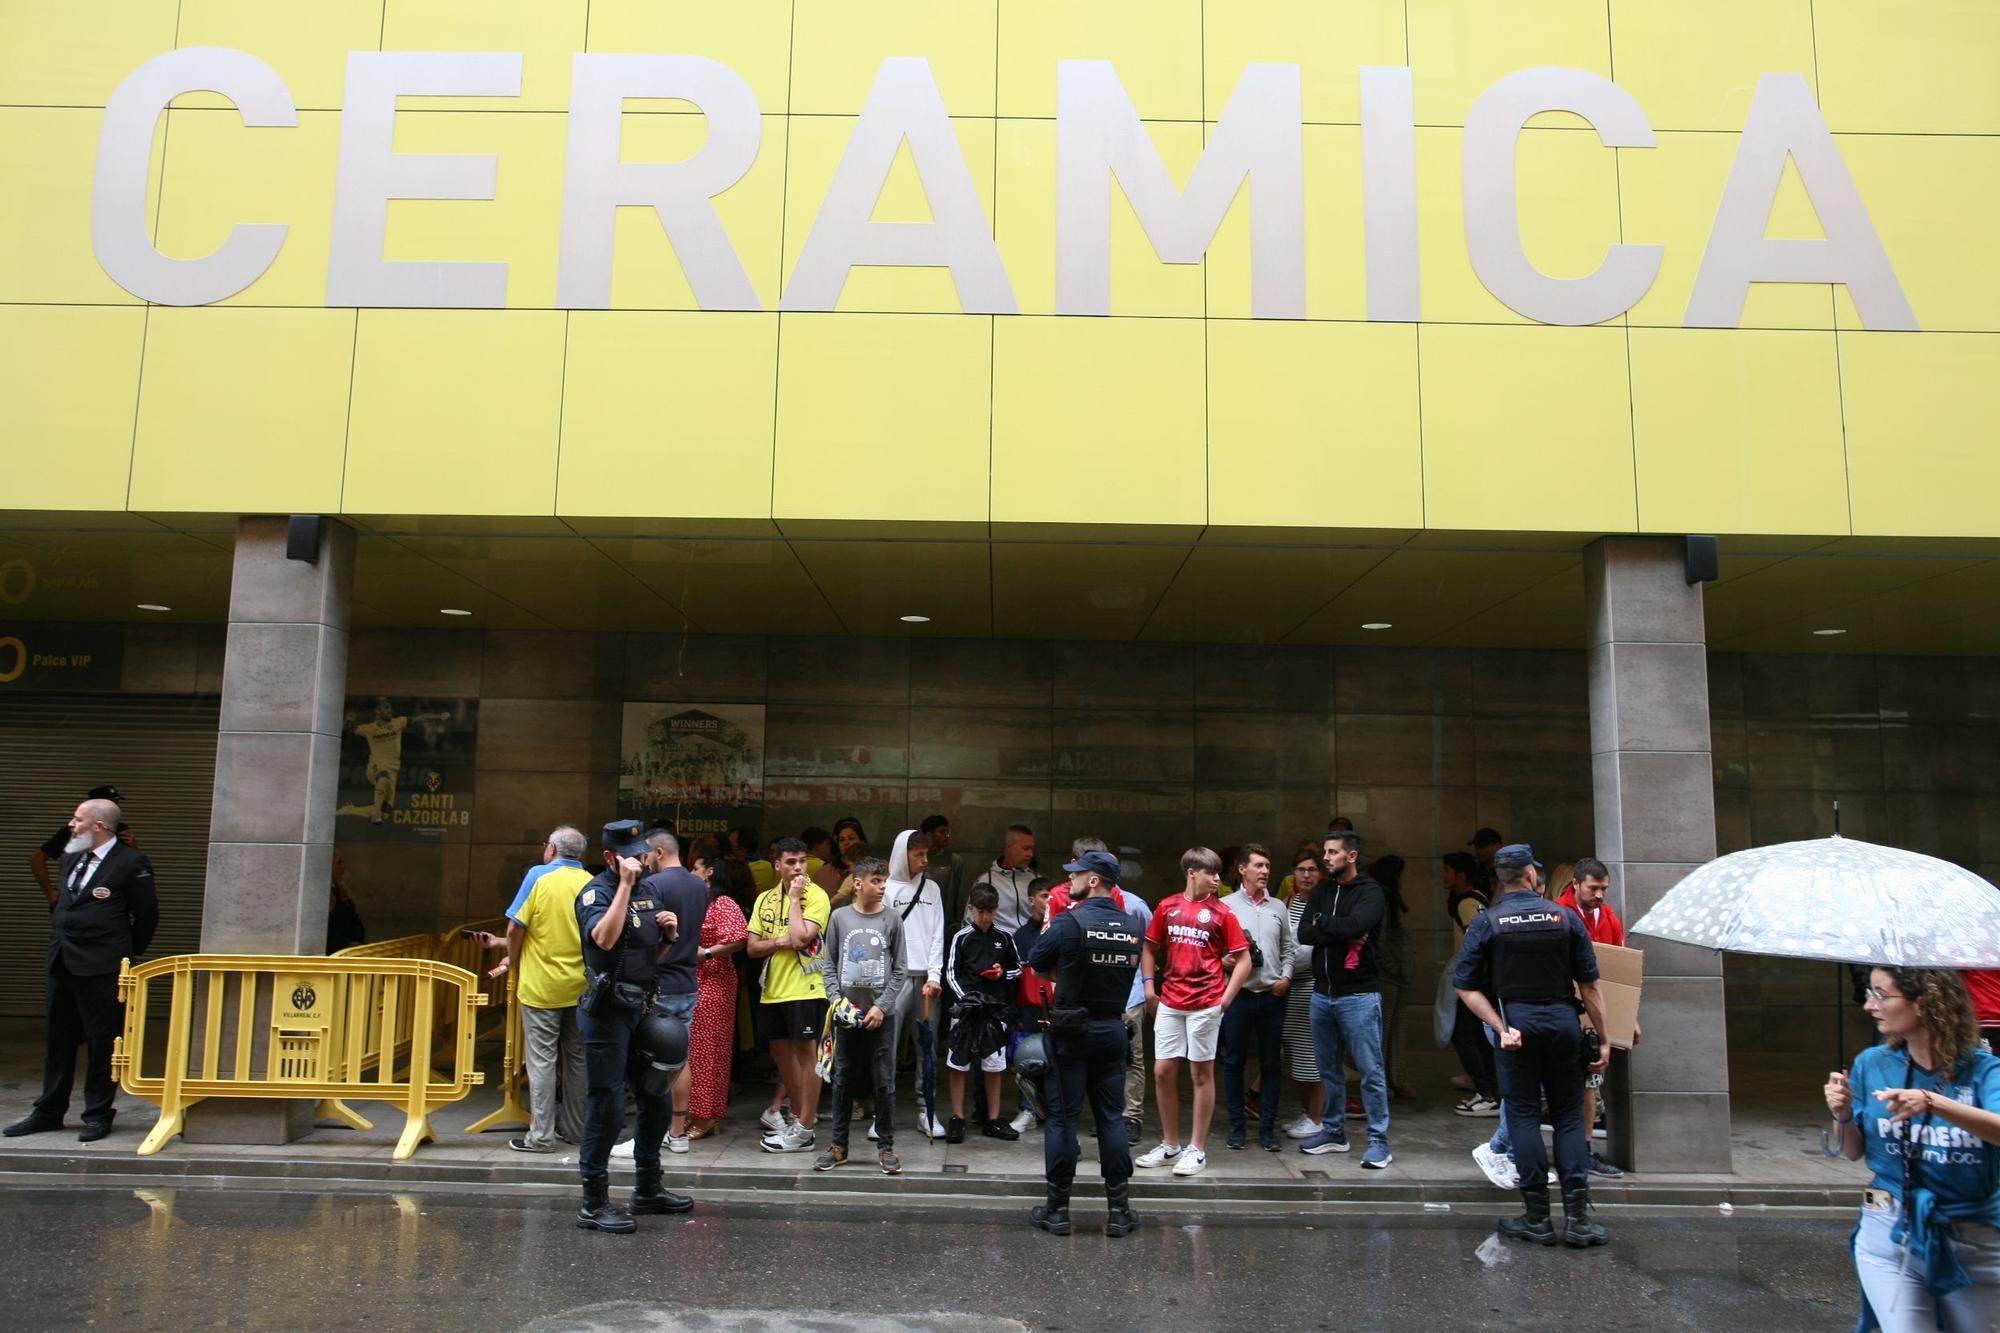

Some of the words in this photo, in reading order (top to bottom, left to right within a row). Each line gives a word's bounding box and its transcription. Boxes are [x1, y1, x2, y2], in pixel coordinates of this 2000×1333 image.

[91, 46, 1920, 331] CERAMICA
[32, 654, 67, 667] Palco
[70, 654, 93, 667] VIP
[670, 719, 718, 729] WINNERS
[410, 793, 455, 809] SANTI
[393, 809, 457, 826] CAZORLA
[460, 810, 470, 826] 8
[1499, 913, 1553, 925] POLICIA
[1086, 930, 1133, 942] POLICIA
[1167, 925, 1210, 942] PAMESA
[1091, 953, 1130, 965] U.I.P.
